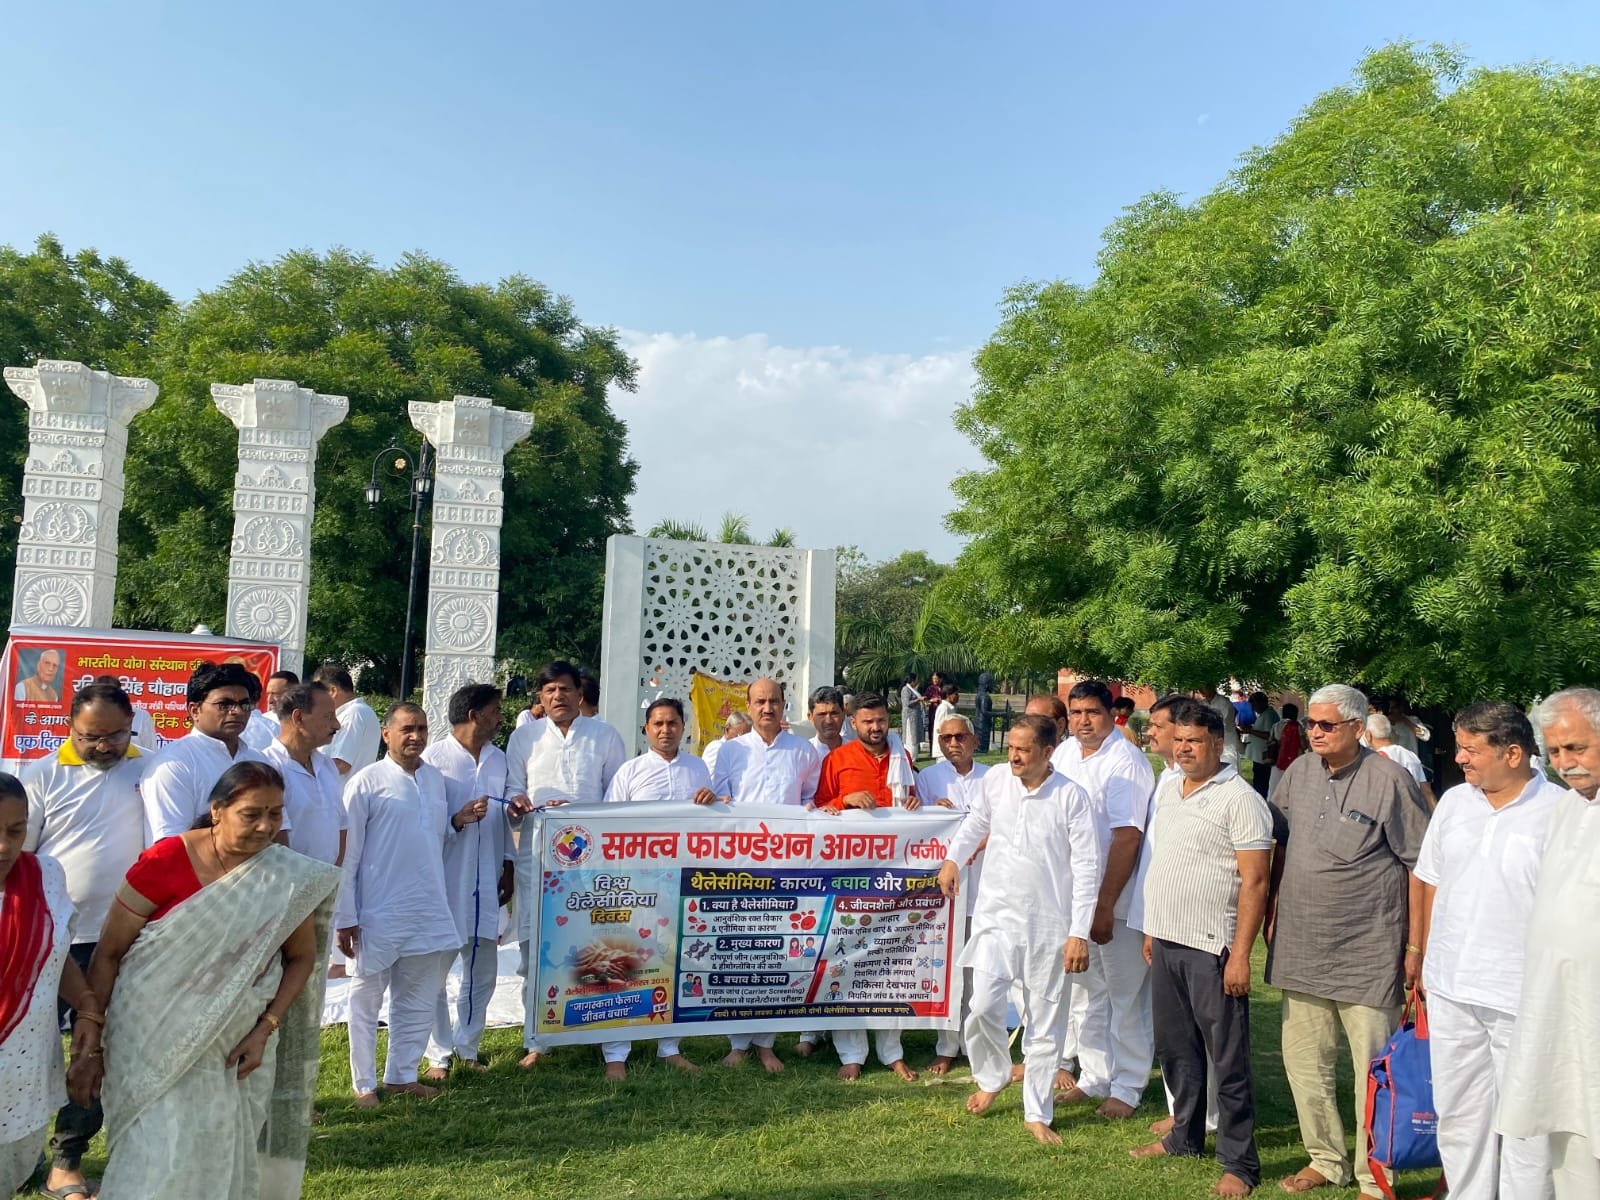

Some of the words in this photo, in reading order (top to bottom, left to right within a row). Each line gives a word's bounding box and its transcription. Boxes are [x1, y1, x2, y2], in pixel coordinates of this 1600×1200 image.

[78, 653, 119, 670] भारतीय
[123, 655, 146, 670] योग
[150, 656, 187, 672] संस्थान
[25, 711, 38, 725] के
[15, 735, 38, 753] एक
[601, 832, 680, 861] समत्व
[687, 821, 815, 862] फाउण्डेशन
[820, 834, 898, 861] आगरा
[595, 874, 630, 891] विश्व
[690, 872, 776, 890] थैलेसीमिया:
[780, 876, 827, 891] कारण,
[831, 876, 871, 890] बचाव
[874, 872, 903, 891] और
[567, 891, 658, 910] थैलेसीमिया
[702, 901, 710, 910] 1.
[712, 901, 729, 910] क्या
[731, 898, 739, 910] है
[740, 899, 795, 910] थैलेसीमिया?
[838, 900, 848, 910] 4.
[897, 898, 913, 908] और
[915, 897, 942, 906] प्रबंधन
[590, 909, 631, 923] दिवस
[763, 913, 783, 922] विकार
[878, 914, 900, 923] आहार
[719, 924, 745, 934] एनीमिया
[719, 939, 729, 948] 2.
[731, 939, 752, 951] मुख्य
[755, 939, 781, 948] कारण
[874, 937, 900, 946] व्यायाम
[854, 959, 881, 968] संक्रमण
[882, 957, 890, 966] से
[891, 958, 913, 966] बचाव
[711, 976, 721, 984] 3.
[751, 973, 760, 983] के
[762, 975, 786, 984] उपाय
[852, 980, 884, 990] चिकित्सा
[886, 979, 917, 990] देखभाल
[741, 988, 768, 996] (Carrier
